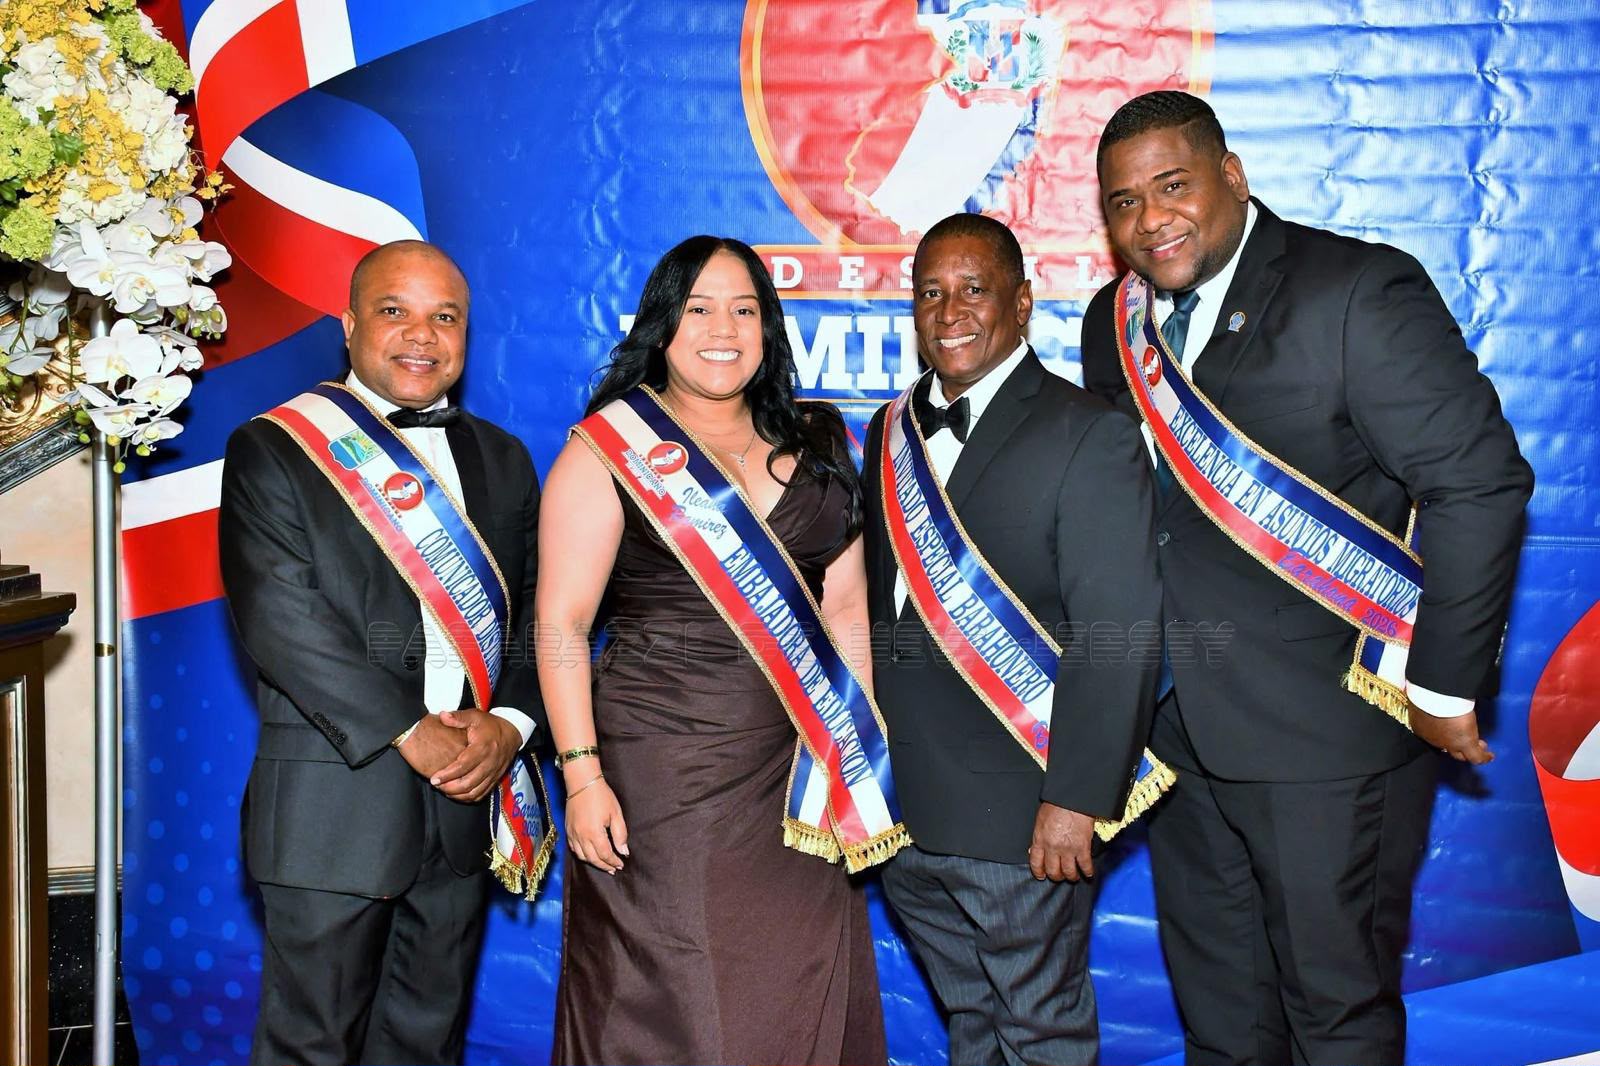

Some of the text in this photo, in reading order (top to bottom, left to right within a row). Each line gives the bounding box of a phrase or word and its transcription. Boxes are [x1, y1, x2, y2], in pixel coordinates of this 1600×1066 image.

[415, 528, 493, 629] COMUNICADOR
[893, 441, 1051, 704] INVITADO ESPECIAL BARAHONERO
[1168, 407, 1422, 619] EXCELENCIA EN ASUNTOS MIGRATORIOS
[721, 544, 812, 672] EMBAJADORA
[800, 659, 828, 696] DE
[1277, 547, 1398, 638] Barahona 2026
